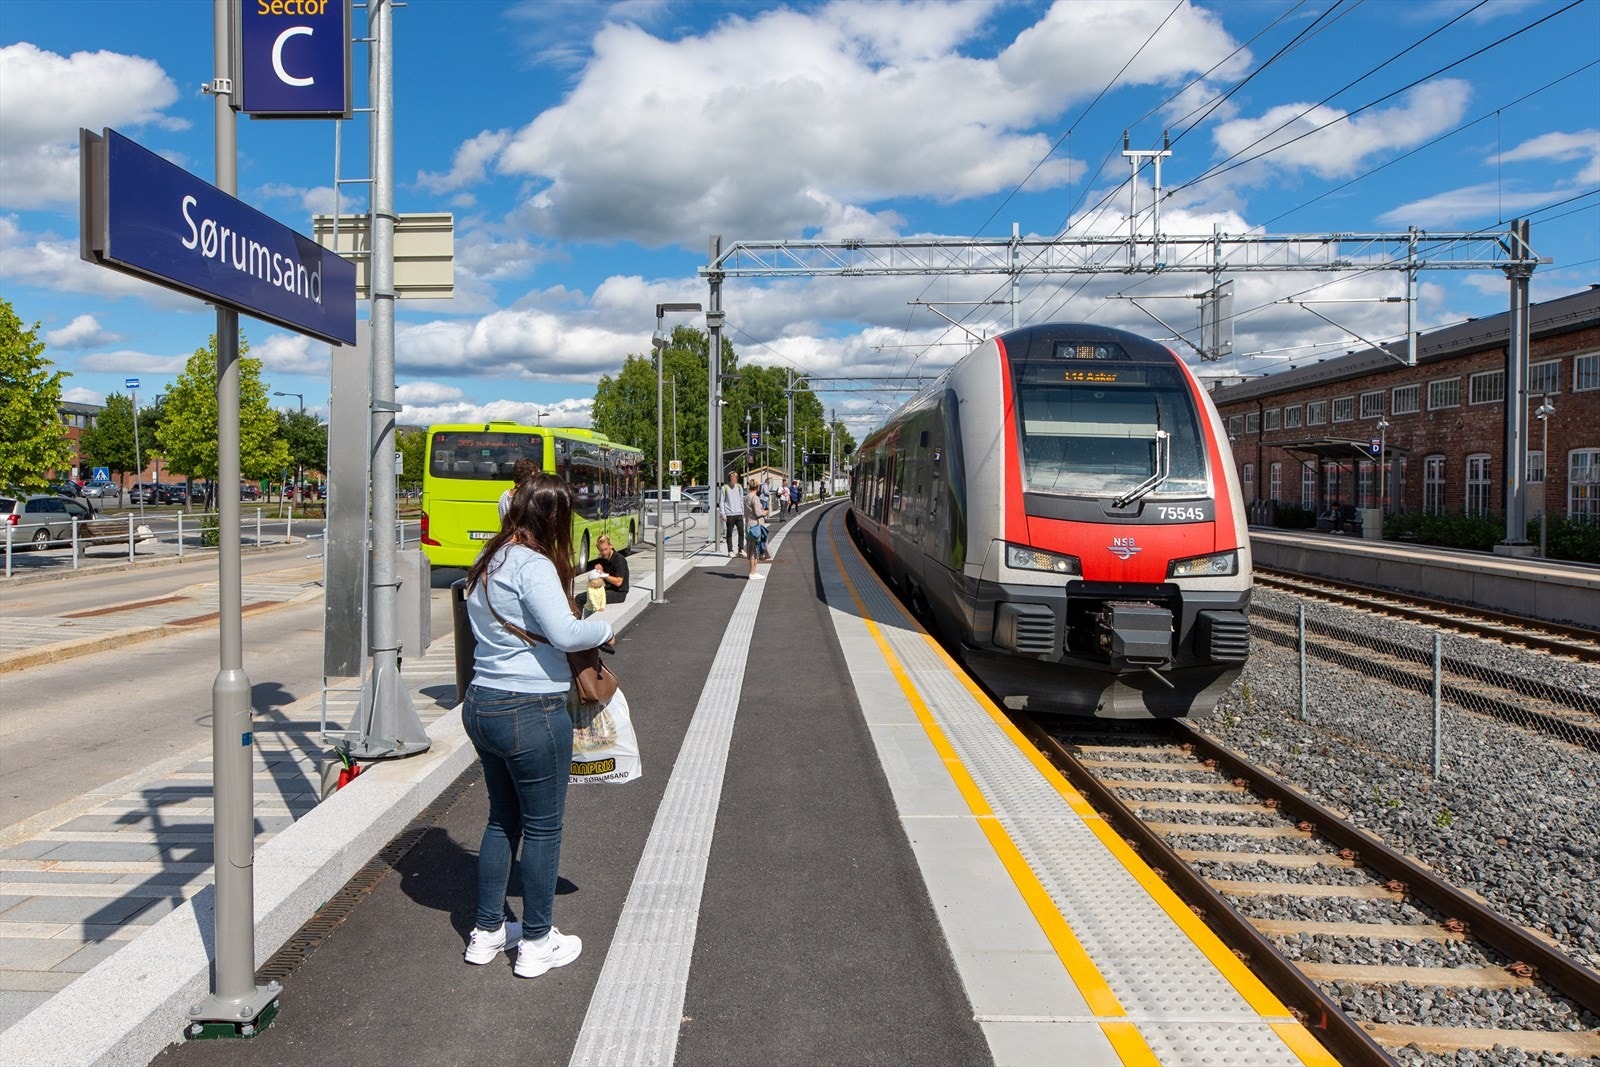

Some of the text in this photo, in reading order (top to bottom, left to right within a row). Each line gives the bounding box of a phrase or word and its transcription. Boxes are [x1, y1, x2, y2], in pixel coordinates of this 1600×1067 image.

[257, 0, 328, 15] Sector
[271, 26, 315, 87] C
[181, 194, 323, 304] Sørumsand
[1065, 371, 1084, 381] L14
[1372, 444, 1380, 452] D
[1158, 506, 1205, 520] 75545
[1113, 537, 1135, 547] NSB
